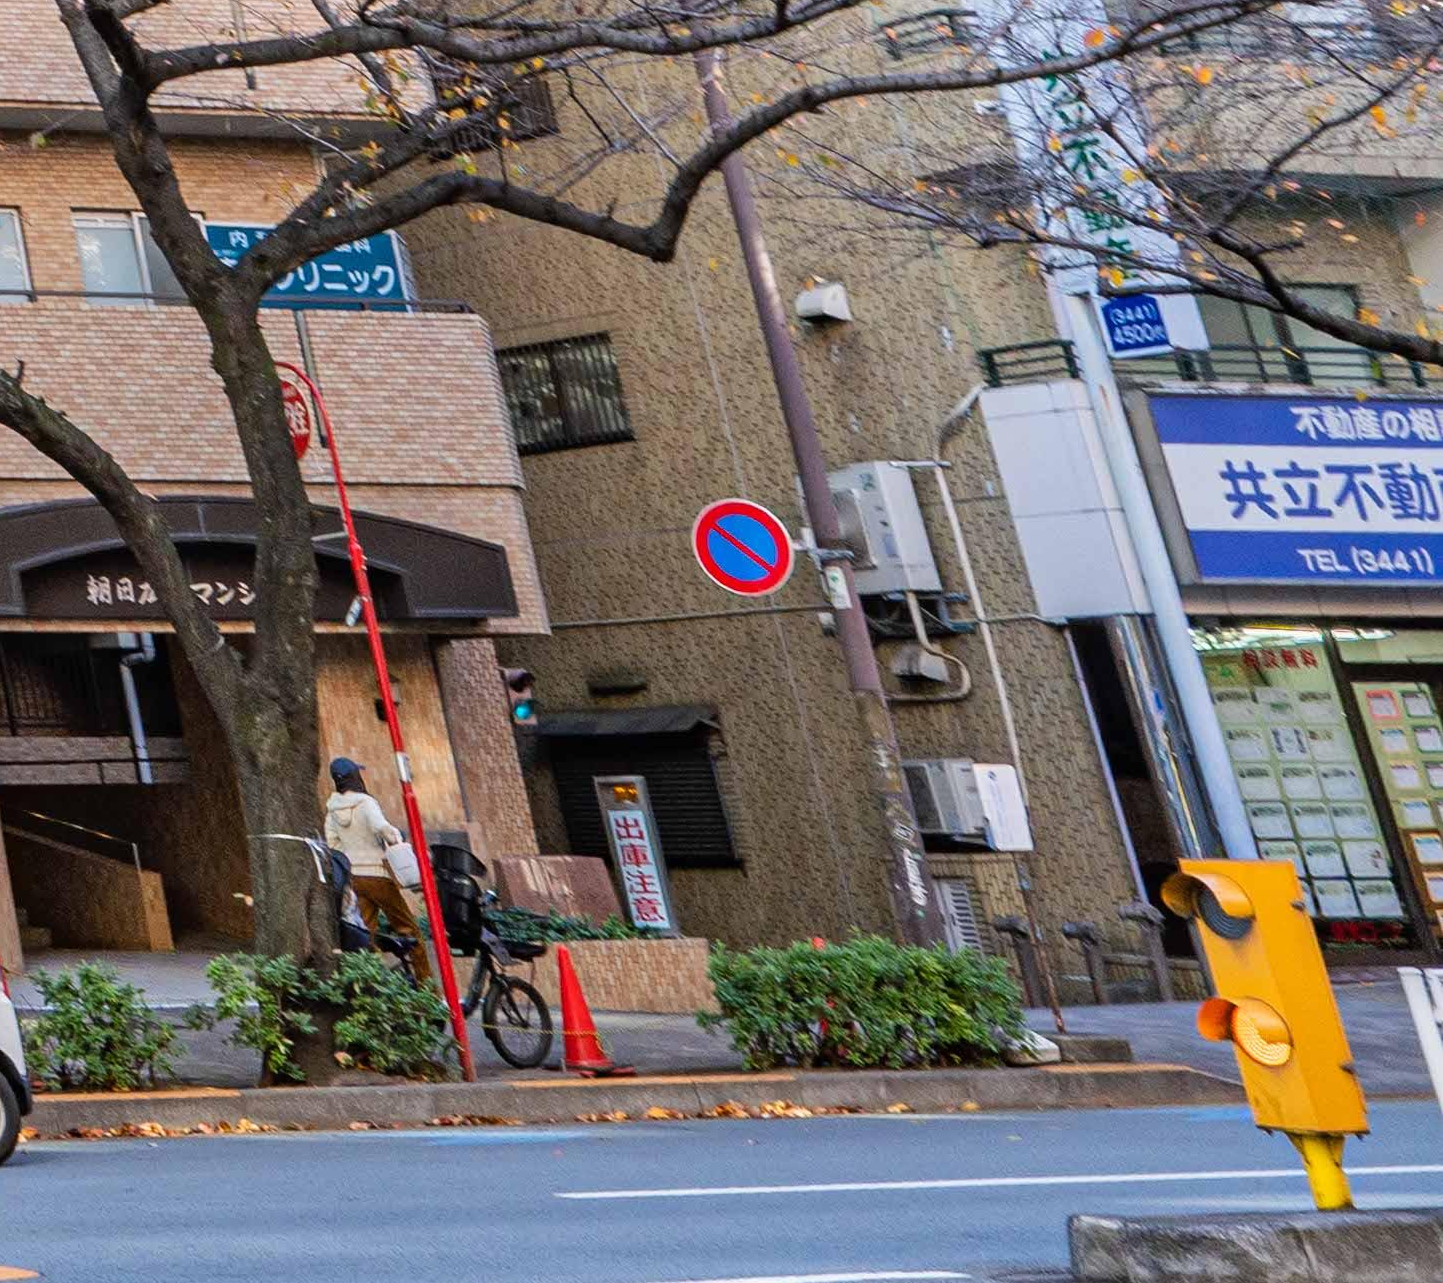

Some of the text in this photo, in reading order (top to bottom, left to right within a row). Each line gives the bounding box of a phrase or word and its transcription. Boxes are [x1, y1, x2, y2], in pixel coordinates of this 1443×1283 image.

[1220, 459, 1443, 522] 共立不動
[1296, 546, 1434, 576] TEL (3441)
[614, 816, 666, 923] 出庫注意
